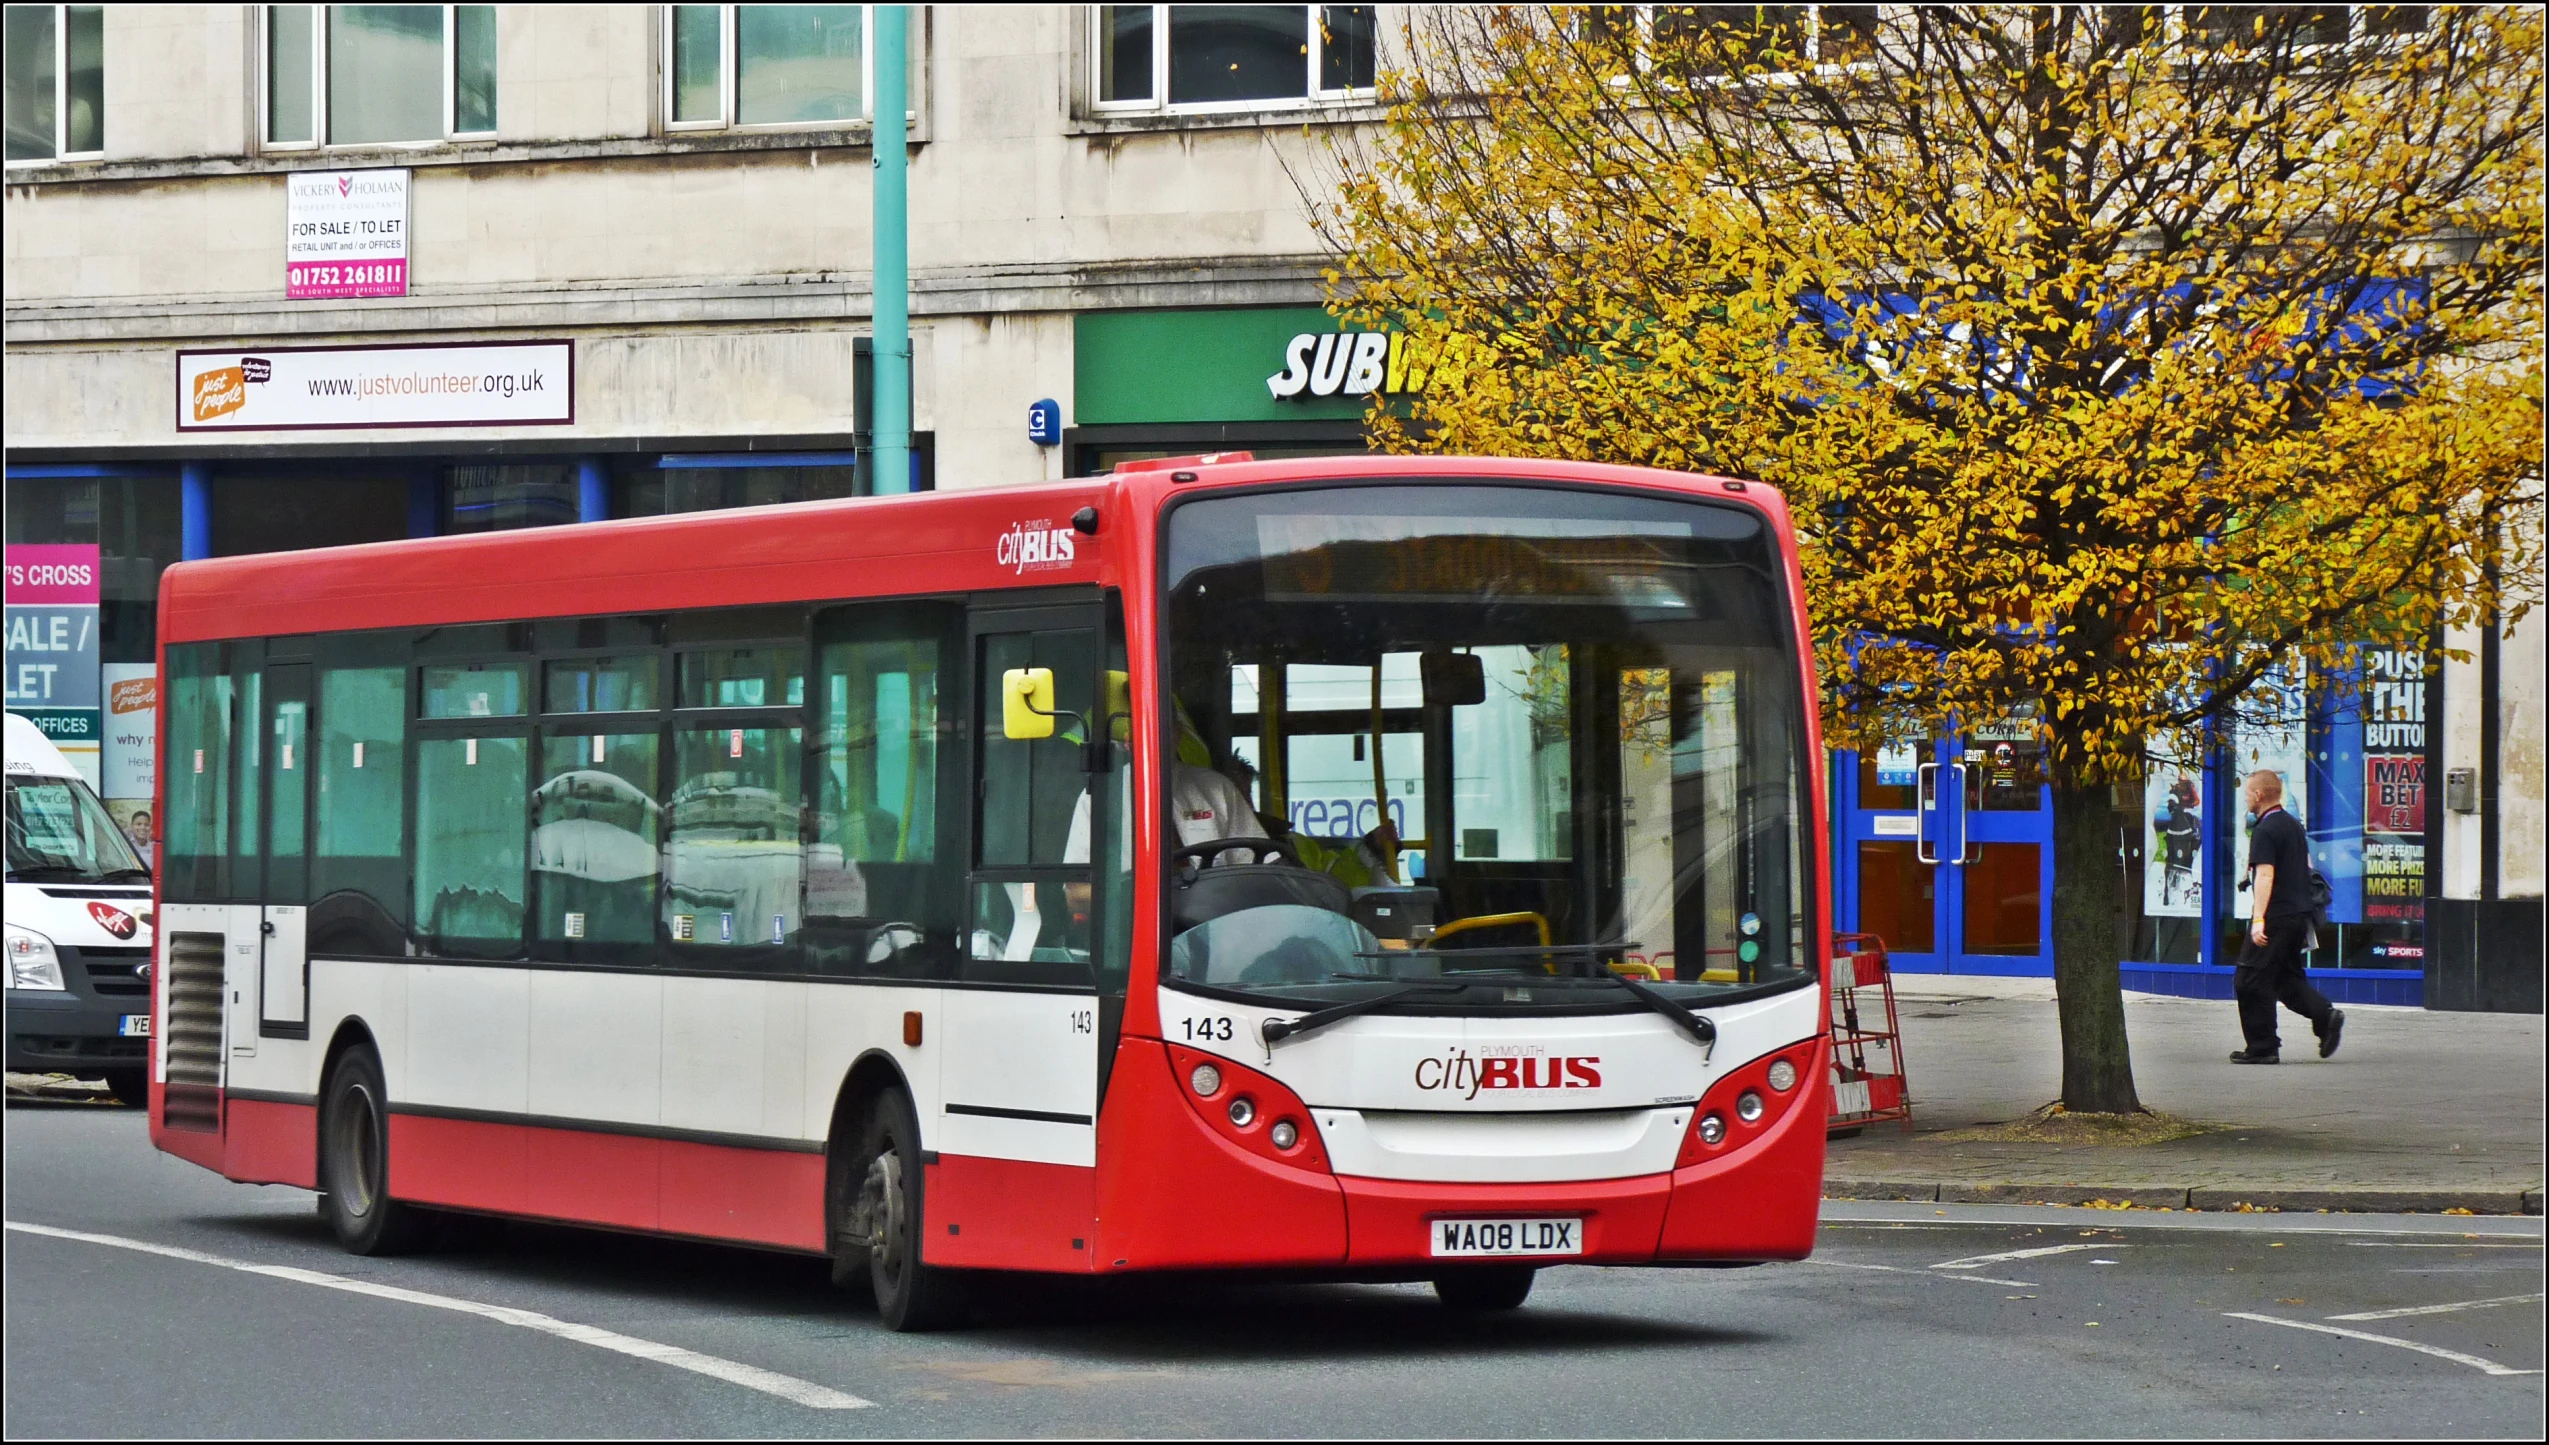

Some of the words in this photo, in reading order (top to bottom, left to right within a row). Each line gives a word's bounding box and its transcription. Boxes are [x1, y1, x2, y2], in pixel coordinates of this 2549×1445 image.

[294, 184, 336, 198] VICKERY
[354, 182, 402, 194] HOLMAN
[292, 204, 335, 212] PROPERTY
[341, 202, 402, 210] CONSULTANTS
[292, 223, 316, 236] FOR
[320, 222, 350, 234] SALE
[360, 220, 376, 234] TO
[380, 220, 401, 232] LET
[292, 242, 318, 252] RETAIL
[320, 242, 338, 250] UNIT
[340, 241, 353, 250] and
[359, 242, 366, 250] or
[369, 240, 401, 249] OFFICES
[291, 267, 340, 286] 01752
[344, 265, 401, 284] 261811
[194, 371, 228, 404] just
[308, 368, 544, 400] www.justvolunteer.org.uk
[200, 382, 242, 416] people
[6, 565, 24, 586] 'S
[28, 565, 92, 586] CROSS
[6, 664, 58, 698] LET
[112, 681, 144, 703] just
[2367, 682, 2425, 721] THE
[32, 718, 88, 733] OFFICES
[116, 734, 144, 748] why
[128, 757, 154, 768] Help
[2375, 762, 2424, 784] MAX
[2381, 785, 2420, 806] BET
[2391, 807, 2412, 828] £2
[2366, 844, 2394, 856] MORE
[2367, 860, 2399, 874] MORE
[2367, 878, 2406, 896] MORE
[2367, 904, 2402, 917] BRING
[2373, 946, 2386, 956] sky
[2388, 948, 2424, 956] SPORTS
[133, 1018, 151, 1033] YE
[1072, 1011, 1091, 1034] 143
[1182, 1017, 1232, 1040] 143
[1481, 1046, 1544, 1058] PLYMOUTH
[1444, 1223, 1513, 1250] WA08
[1522, 1222, 1572, 1249] LDX
